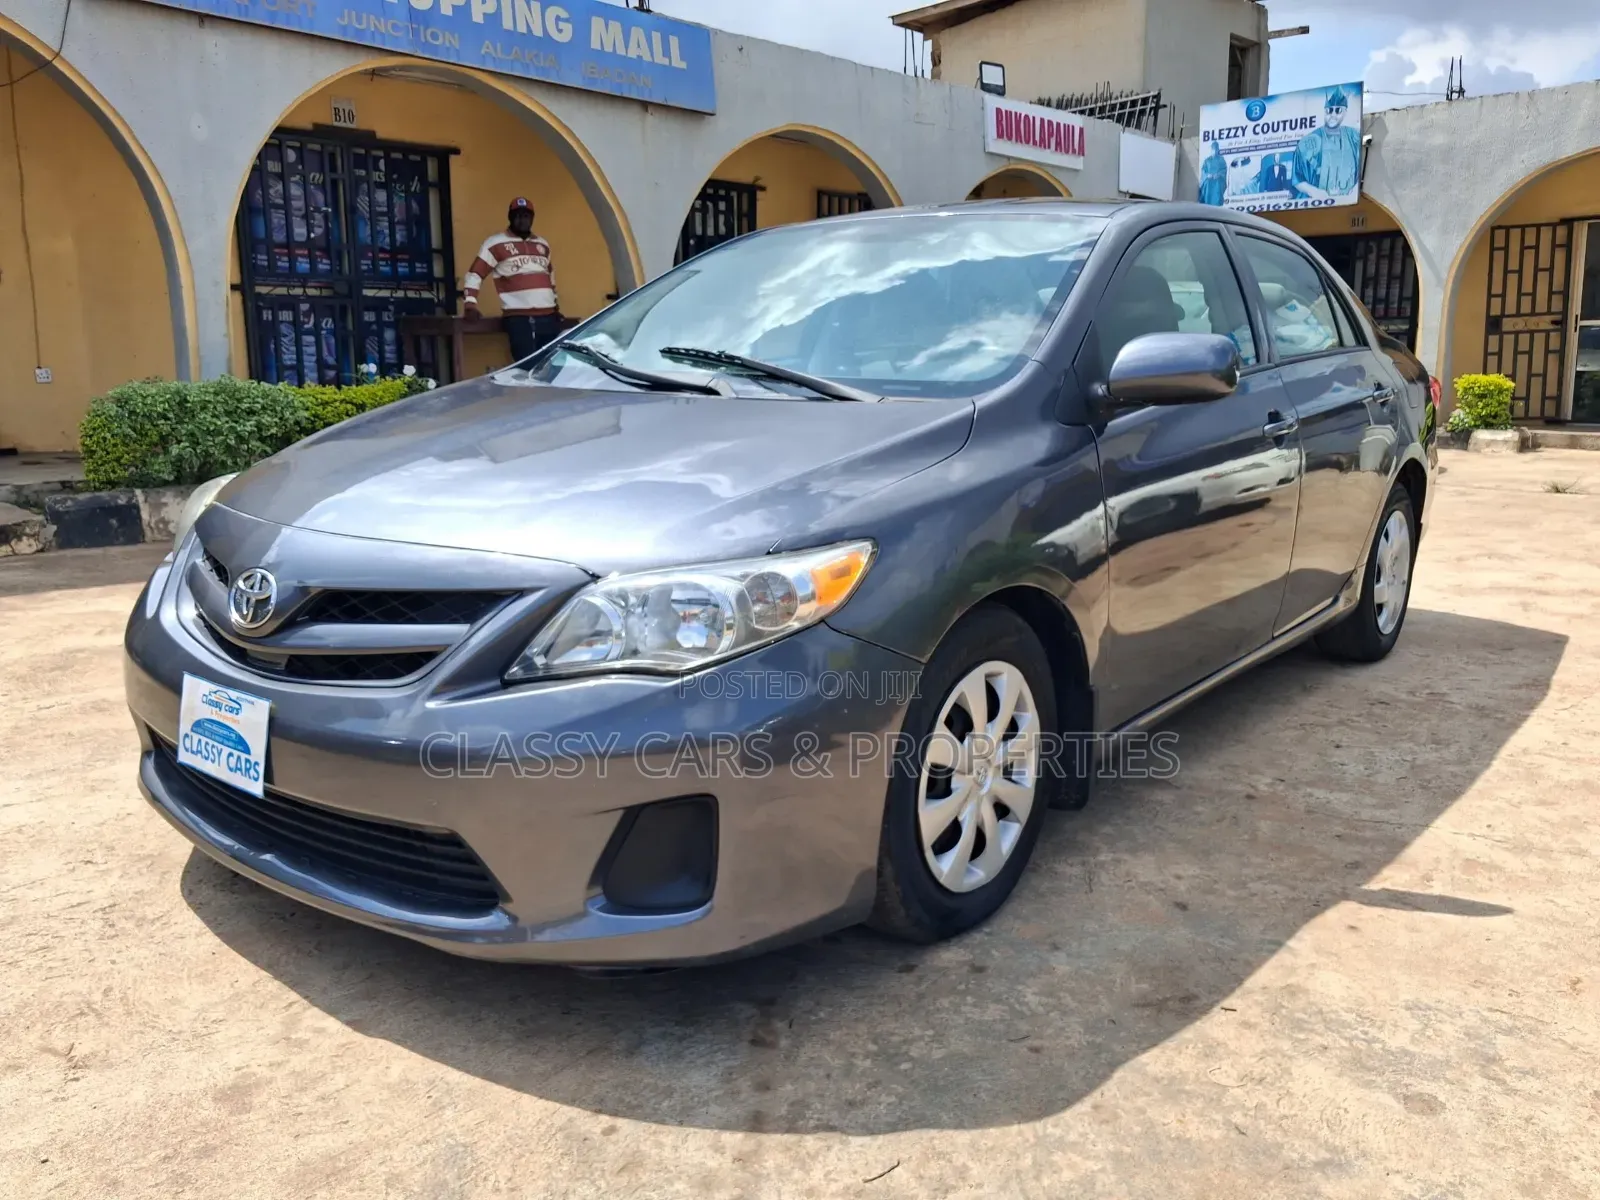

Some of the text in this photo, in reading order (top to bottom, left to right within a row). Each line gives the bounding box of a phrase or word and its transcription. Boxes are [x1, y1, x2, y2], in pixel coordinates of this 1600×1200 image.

[336, 9, 460, 49] JUNCTION
[481, 40, 560, 70] ALAKIA
[581, 62, 653, 88] IBADAN
[590, 16, 688, 70] MALL
[333, 106, 355, 124] B10
[995, 107, 1085, 157] BUKOLAPAULA
[1203, 115, 1317, 142] BLEZZY COUTURE
[1228, 198, 1336, 213] 9051691400
[224, 704, 240, 716] cars
[182, 733, 224, 767] CLASSY
[226, 752, 260, 782] CARS
